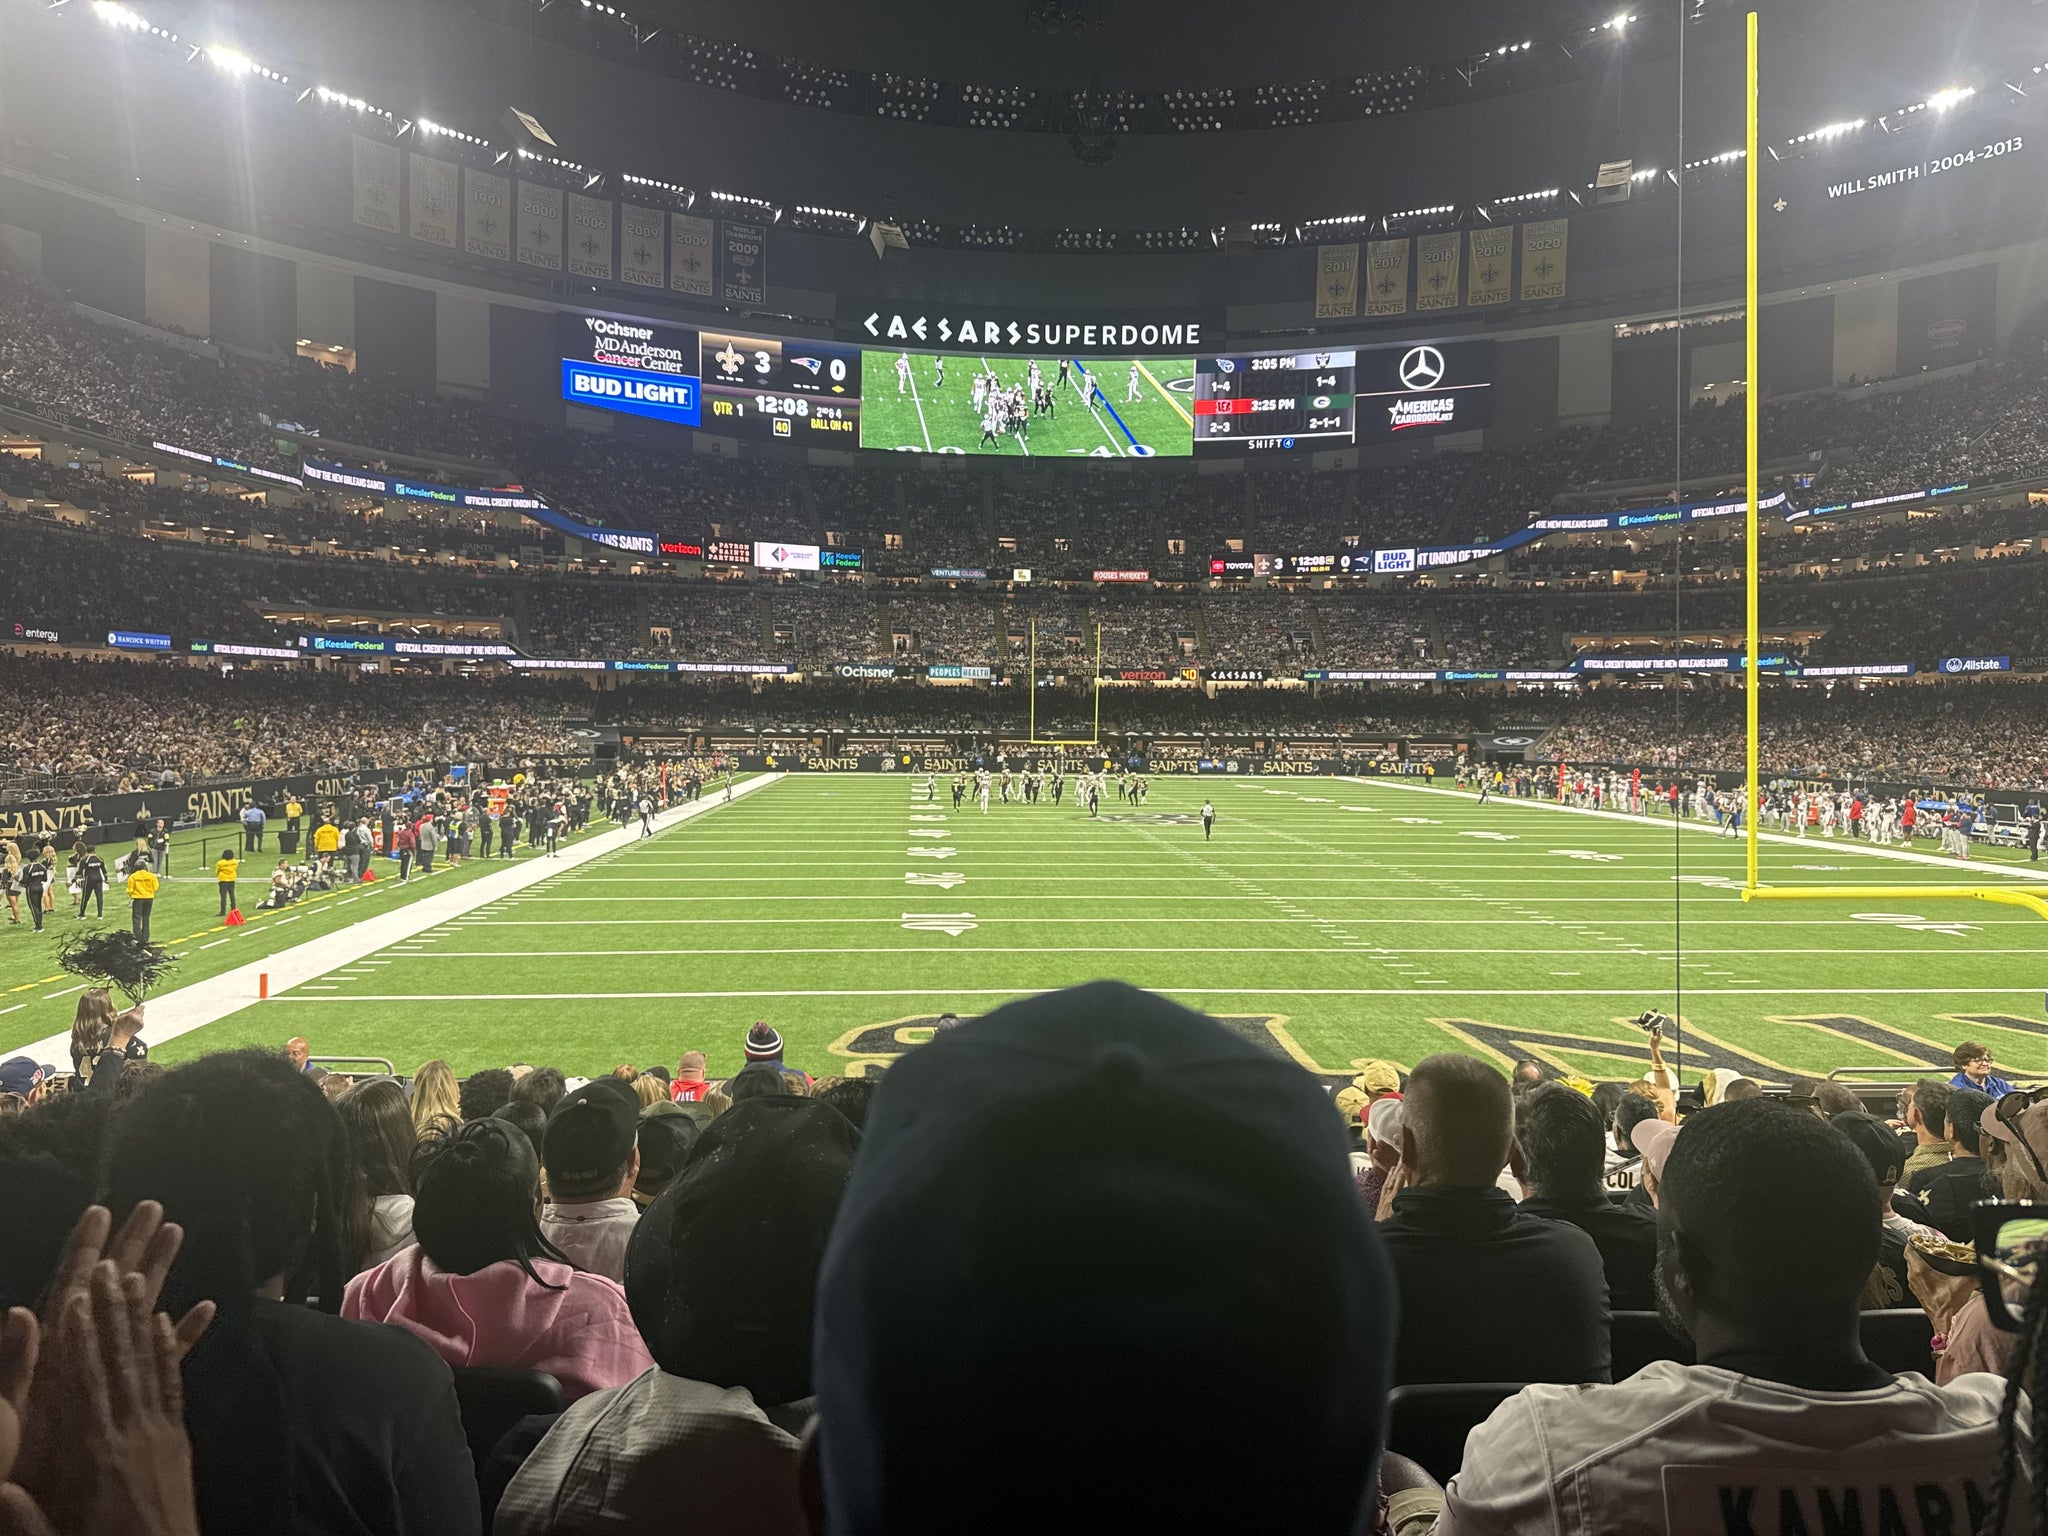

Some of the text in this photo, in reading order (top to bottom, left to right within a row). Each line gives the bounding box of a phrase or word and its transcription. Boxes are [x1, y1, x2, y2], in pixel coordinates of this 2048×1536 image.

[1827, 179, 1866, 199] WILL
[1868, 166, 1919, 190] SMITH
[473, 190, 502, 208] 1991
[524, 202, 557, 220] 2000
[575, 214, 606, 230] 2006
[627, 223, 658, 239] 2009
[677, 232, 708, 248] 2009
[1528, 239, 1562, 252] 2020
[468, 241, 507, 260] SAINTS
[728, 241, 759, 256] 2009
[1476, 245, 1505, 258] 2019
[520, 251, 559, 268] SAINTS
[1374, 257, 1401, 269] 2017
[1424, 251, 1453, 263] 2018
[571, 263, 609, 279] SAINTS
[1325, 262, 1351, 273] 2011
[624, 272, 662, 288] SAINTS
[673, 279, 710, 295] SAINTS
[1524, 287, 1562, 299] SAINTS
[726, 288, 762, 302] SAINTS
[1470, 292, 1508, 305] SAINTS
[1368, 304, 1404, 315] SAINTS
[1419, 297, 1456, 309] SAINTS
[1318, 307, 1353, 317] SAINTS
[594, 319, 653, 340] Ochsner
[863, 312, 1200, 346] CAESARS SUPERDOME
[595, 336, 682, 361] MD Anderson
[593, 349, 683, 373] Cancer Center
[755, 351, 771, 373] 3
[1251, 357, 1296, 371] 3:05 PM
[829, 359, 846, 381] 0
[1211, 380, 1230, 393] 1-4
[1316, 375, 1336, 388] 1-4
[574, 374, 688, 405] BUD LIGHT
[713, 400, 744, 417] QTR 1
[755, 395, 809, 416] 12:08
[1251, 398, 1295, 412] 3:25 PM
[1388, 398, 1454, 415] AMERICAS
[775, 421, 789, 433] 40
[811, 418, 853, 432] BALL ON 41
[1209, 421, 1230, 433] 2-3
[1309, 416, 1341, 429] 2-1-1
[465, 495, 491, 507] OFFICIAL
[491, 498, 513, 508] CREDIT
[513, 499, 531, 509] UNION
[620, 535, 653, 552] SAINTS
[661, 542, 701, 555] verizon
[836, 553, 861, 561] Keesler
[836, 559, 861, 567] Federal
[1298, 555, 1326, 567] 12:08
[1340, 555, 1351, 568] 0
[1383, 552, 1406, 561] BUD
[1429, 549, 1471, 566] UNION OF
[1225, 562, 1253, 570] TOYOTA
[1274, 557, 1284, 570] 3
[1378, 560, 1411, 570] LIGHT
[931, 569, 986, 578] VENTURE GLOBAL
[26, 628, 58, 642] entergy
[117, 636, 171, 647] HANCOCK WHITNEY
[395, 642, 423, 653] OFFICIAL
[423, 643, 444, 654] CREDIT
[1963, 659, 2001, 670] Allstate
[842, 666, 895, 679] Ochsner
[930, 667, 990, 678] PEOPLES HEALTH
[1120, 670, 1166, 681] verizon
[1183, 670, 1197, 680] 40
[1211, 671, 1263, 681] CAESARS
[808, 758, 858, 770] SAINTS
[1264, 761, 1313, 773] SAINTS
[188, 786, 253, 821] SAINTS
